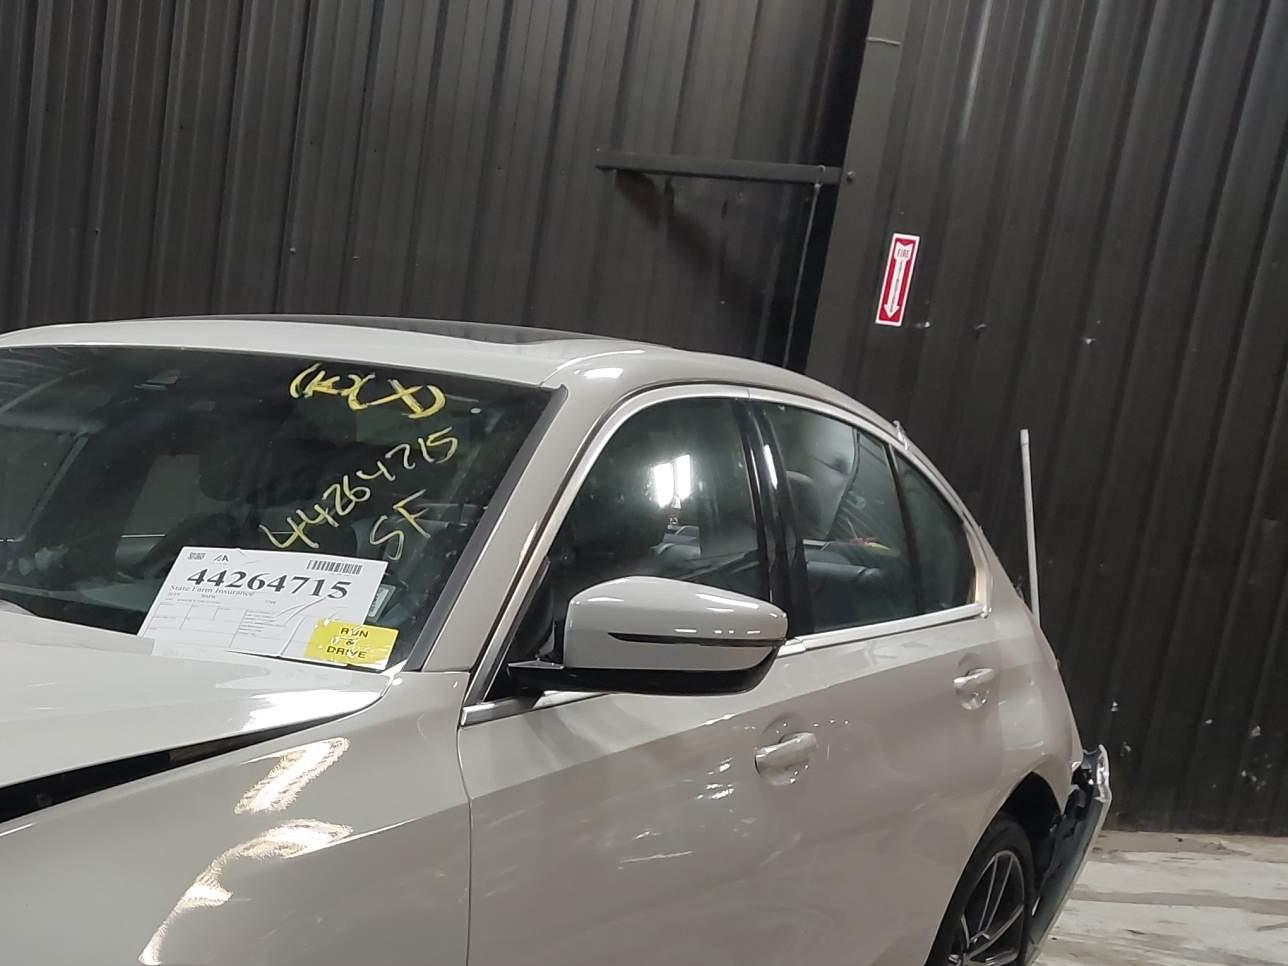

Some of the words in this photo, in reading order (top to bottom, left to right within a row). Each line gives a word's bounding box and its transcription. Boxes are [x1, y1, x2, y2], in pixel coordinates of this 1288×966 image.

[369, 489, 431, 561] SF
[187, 568, 351, 600] 44264715
[215, 588, 255, 597] Insurance
[340, 627, 369, 638] RUN
[326, 645, 368, 659] DRIVE
